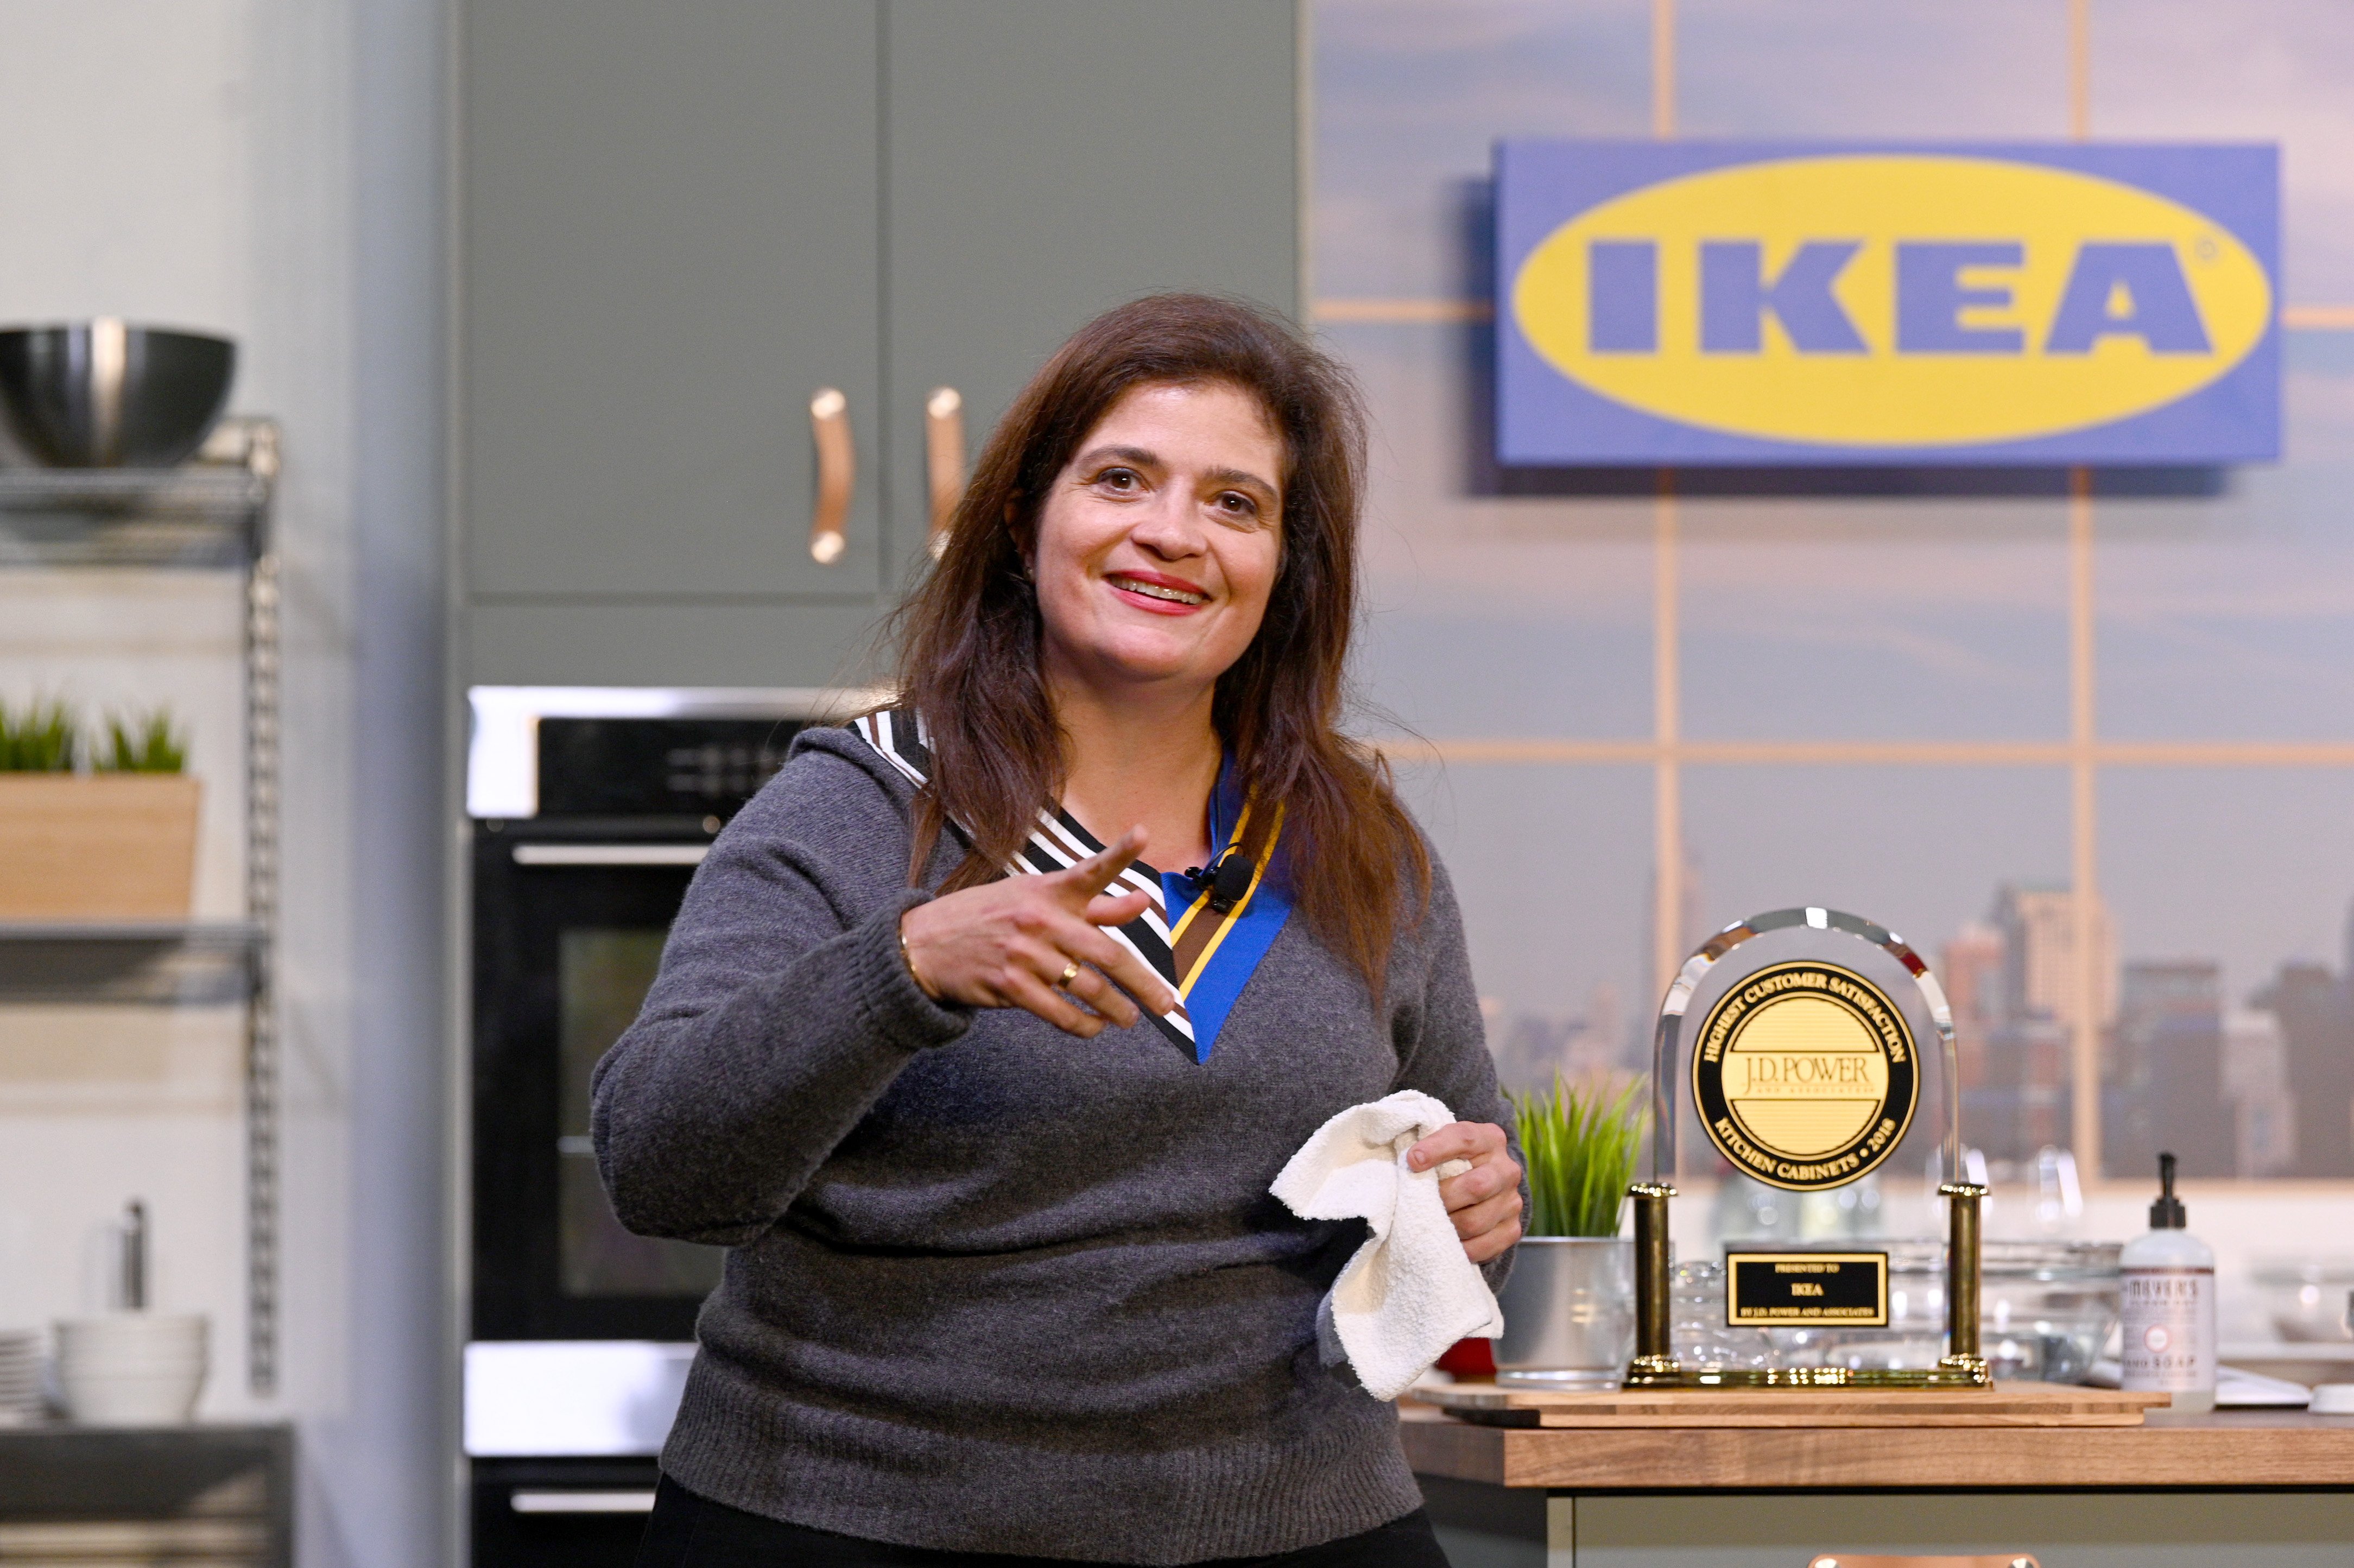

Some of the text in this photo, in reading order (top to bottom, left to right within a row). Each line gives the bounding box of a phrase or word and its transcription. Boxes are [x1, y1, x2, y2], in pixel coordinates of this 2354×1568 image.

[1586, 239, 2216, 356] IKEA
[1704, 972, 1907, 1063] HIGHEST CUSTOMER SATISFACTION
[1783, 1057, 1869, 1083] POWER
[1715, 1117, 1896, 1180] KITCHEN CABINETS 2018
[1775, 1263, 1840, 1274] PRESENTED TO
[1791, 1283, 1824, 1297] IKEA
[1740, 1307, 1752, 1317] BY
[1769, 1307, 1801, 1317] POWER
[1801, 1307, 1822, 1317] AND
[1823, 1307, 1874, 1317] ASSOCIATES
